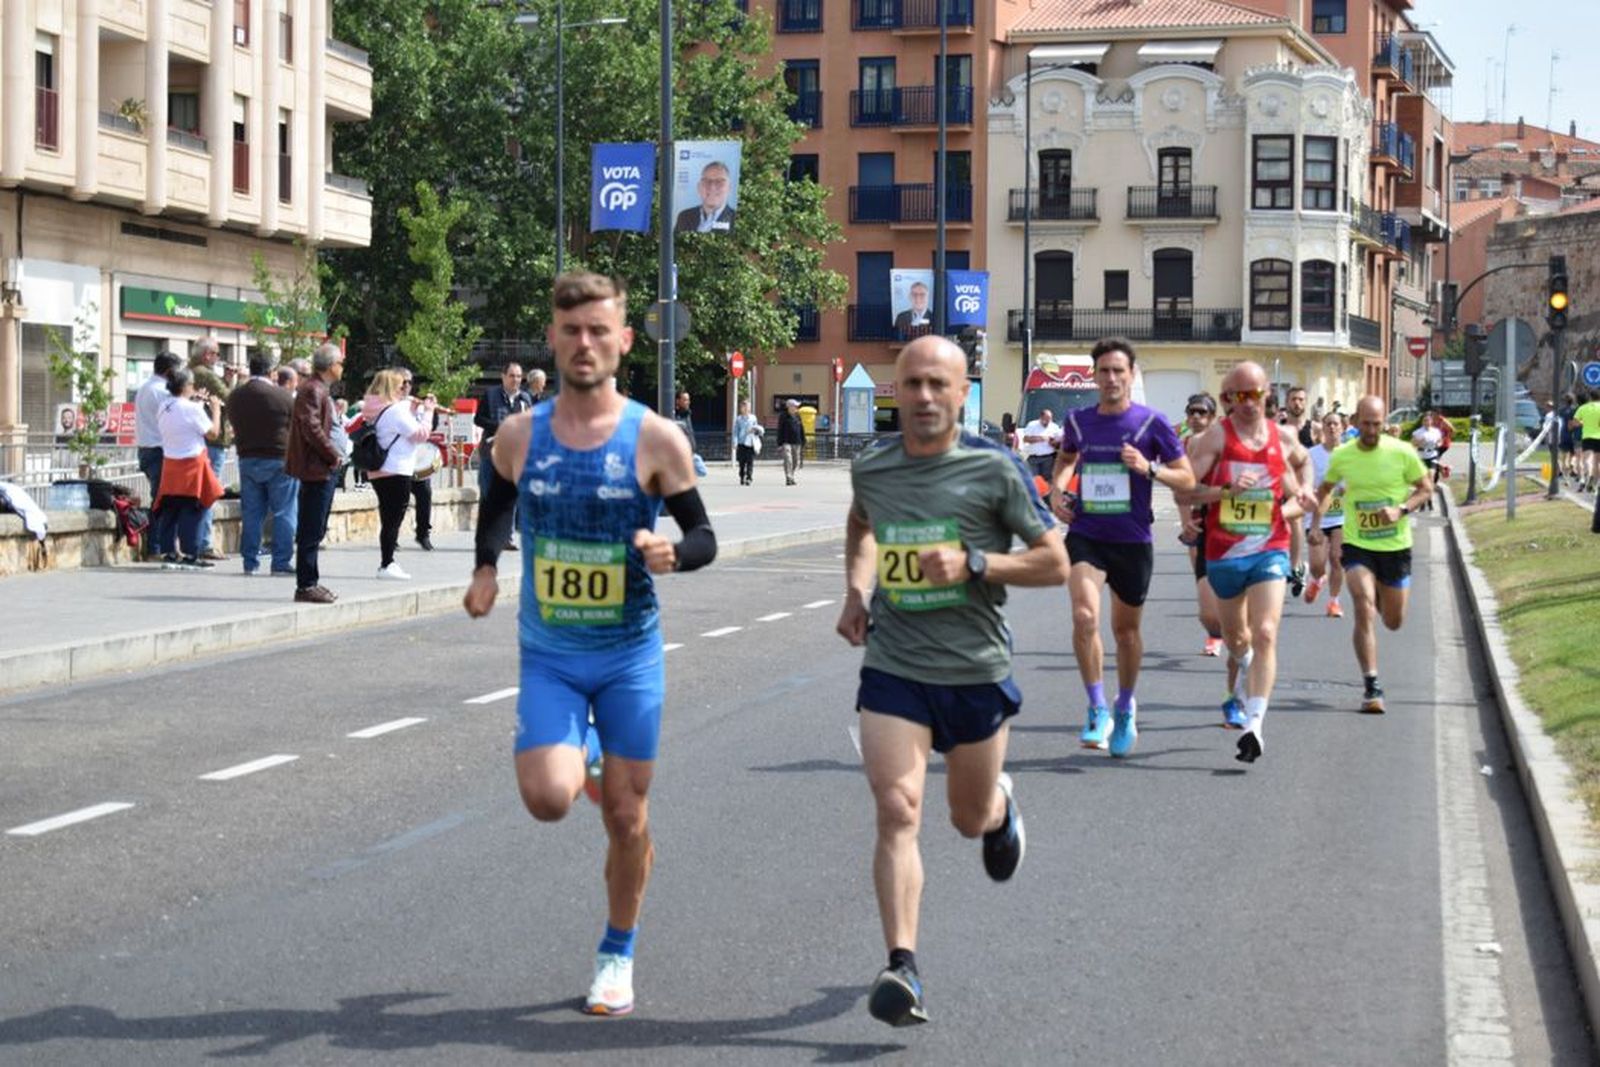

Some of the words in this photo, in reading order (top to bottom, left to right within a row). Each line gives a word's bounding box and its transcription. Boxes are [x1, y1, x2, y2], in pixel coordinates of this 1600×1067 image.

[602, 166, 640, 180] VOTA
[954, 284, 981, 294] VOTA
[884, 549, 924, 583] 20
[543, 566, 609, 601] 180
